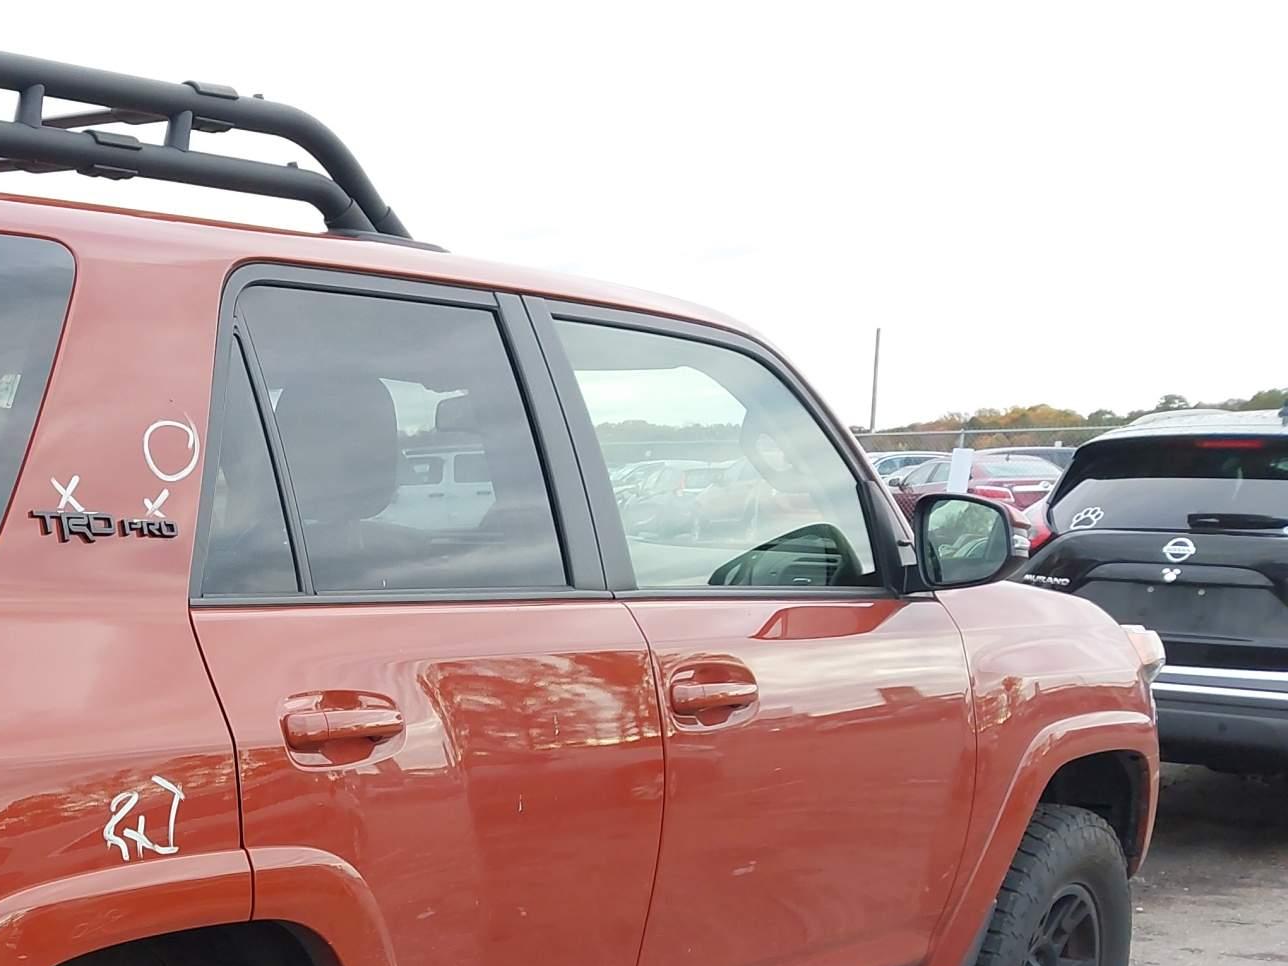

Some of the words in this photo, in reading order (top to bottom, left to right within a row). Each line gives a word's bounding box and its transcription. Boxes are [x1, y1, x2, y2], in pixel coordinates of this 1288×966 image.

[28, 510, 116, 543] TRD
[117, 518, 179, 539] PRO
[1023, 573, 1071, 586] MURANO
